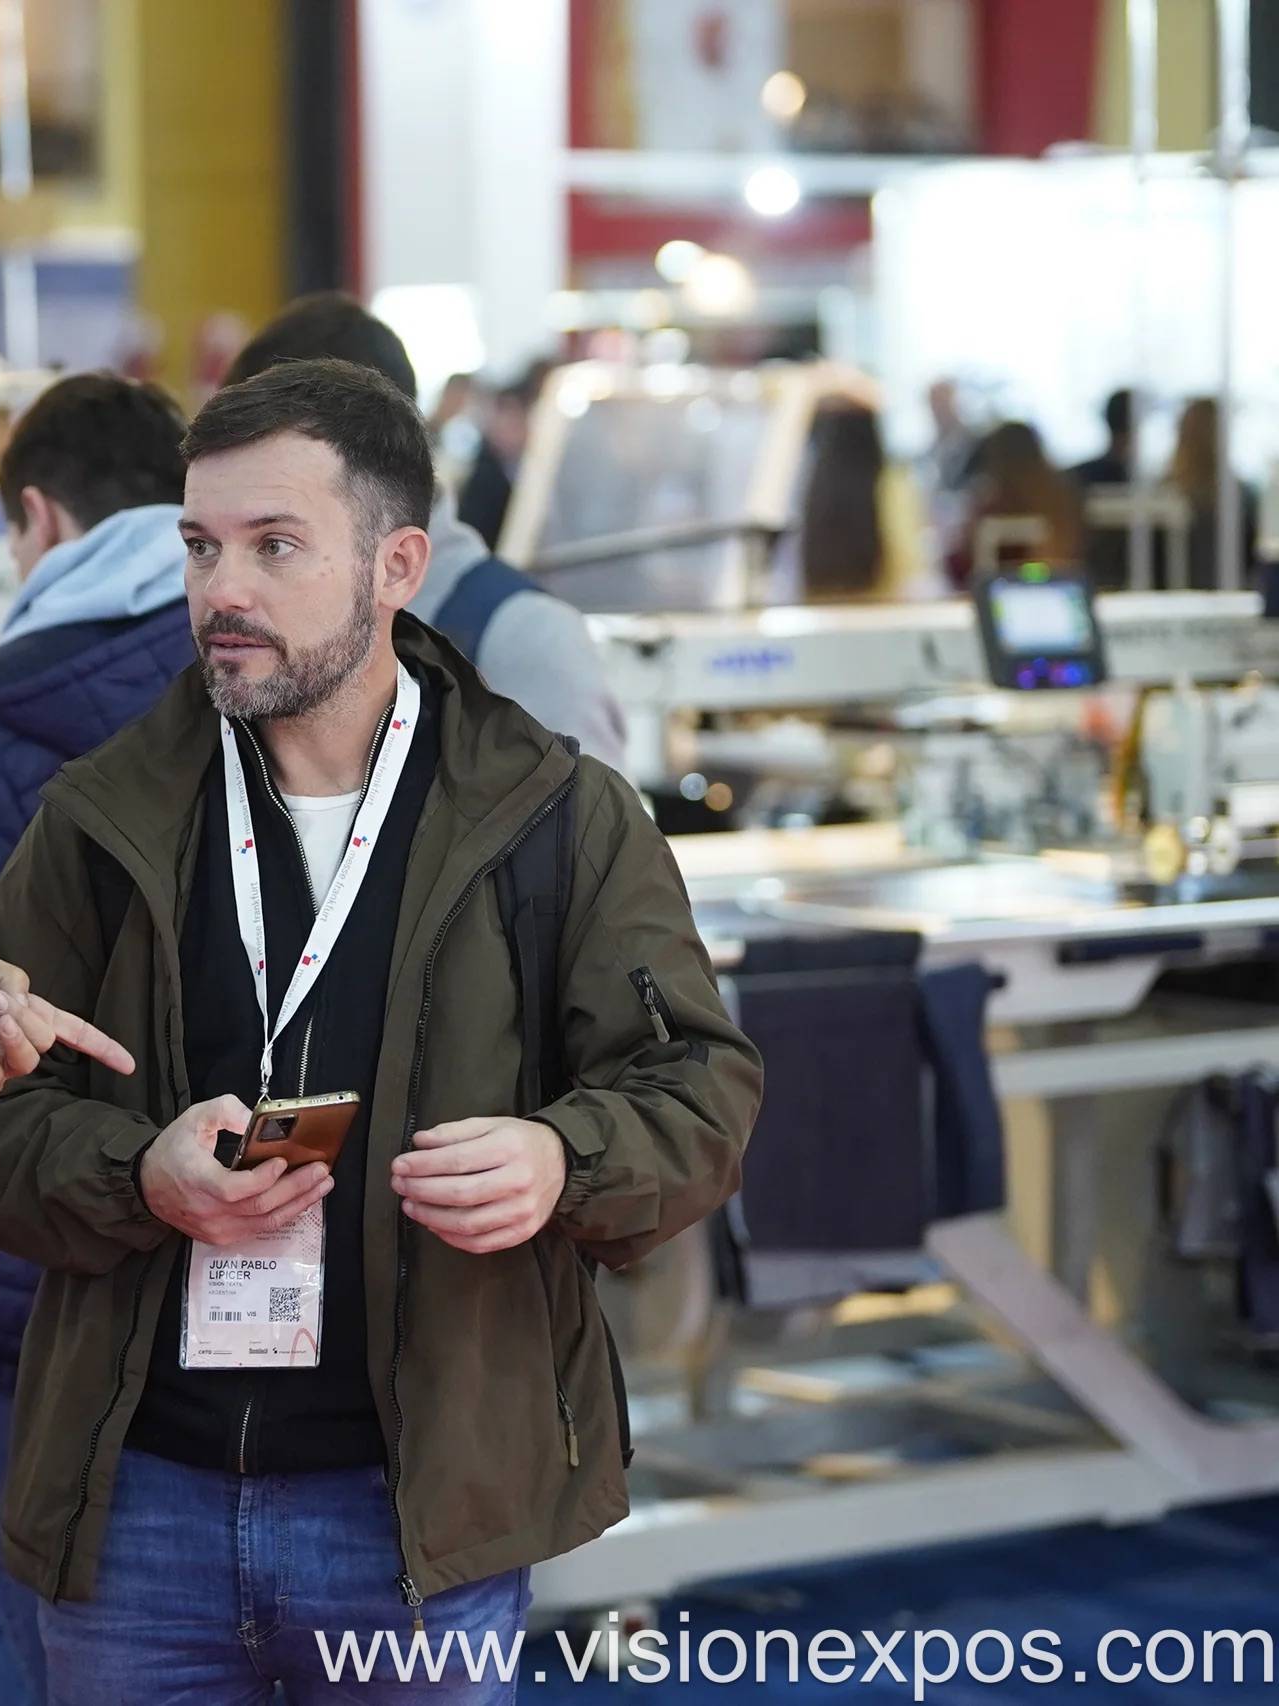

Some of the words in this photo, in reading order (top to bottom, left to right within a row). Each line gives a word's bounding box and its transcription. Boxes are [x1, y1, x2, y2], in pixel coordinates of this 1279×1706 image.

[250, 881, 262, 924] frankfurt
[209, 1260, 238, 1270] JUAN
[240, 1260, 277, 1271] PABLO
[209, 1270, 251, 1280] LIPICER
